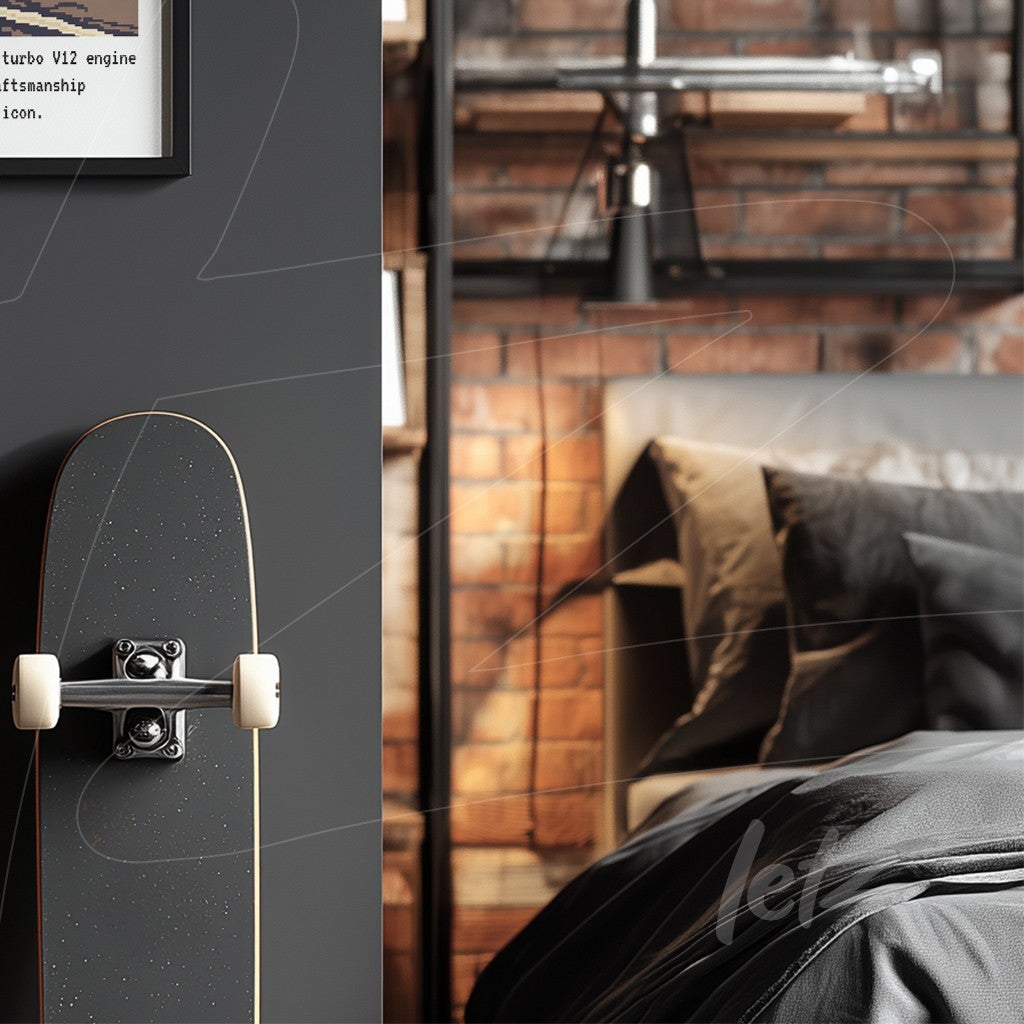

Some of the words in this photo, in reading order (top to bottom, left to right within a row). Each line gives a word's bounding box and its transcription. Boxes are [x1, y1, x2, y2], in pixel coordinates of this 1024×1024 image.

[52, 50, 77, 65] V12
[85, 50, 137, 68] engine
[2, 105, 42, 120] icon.
